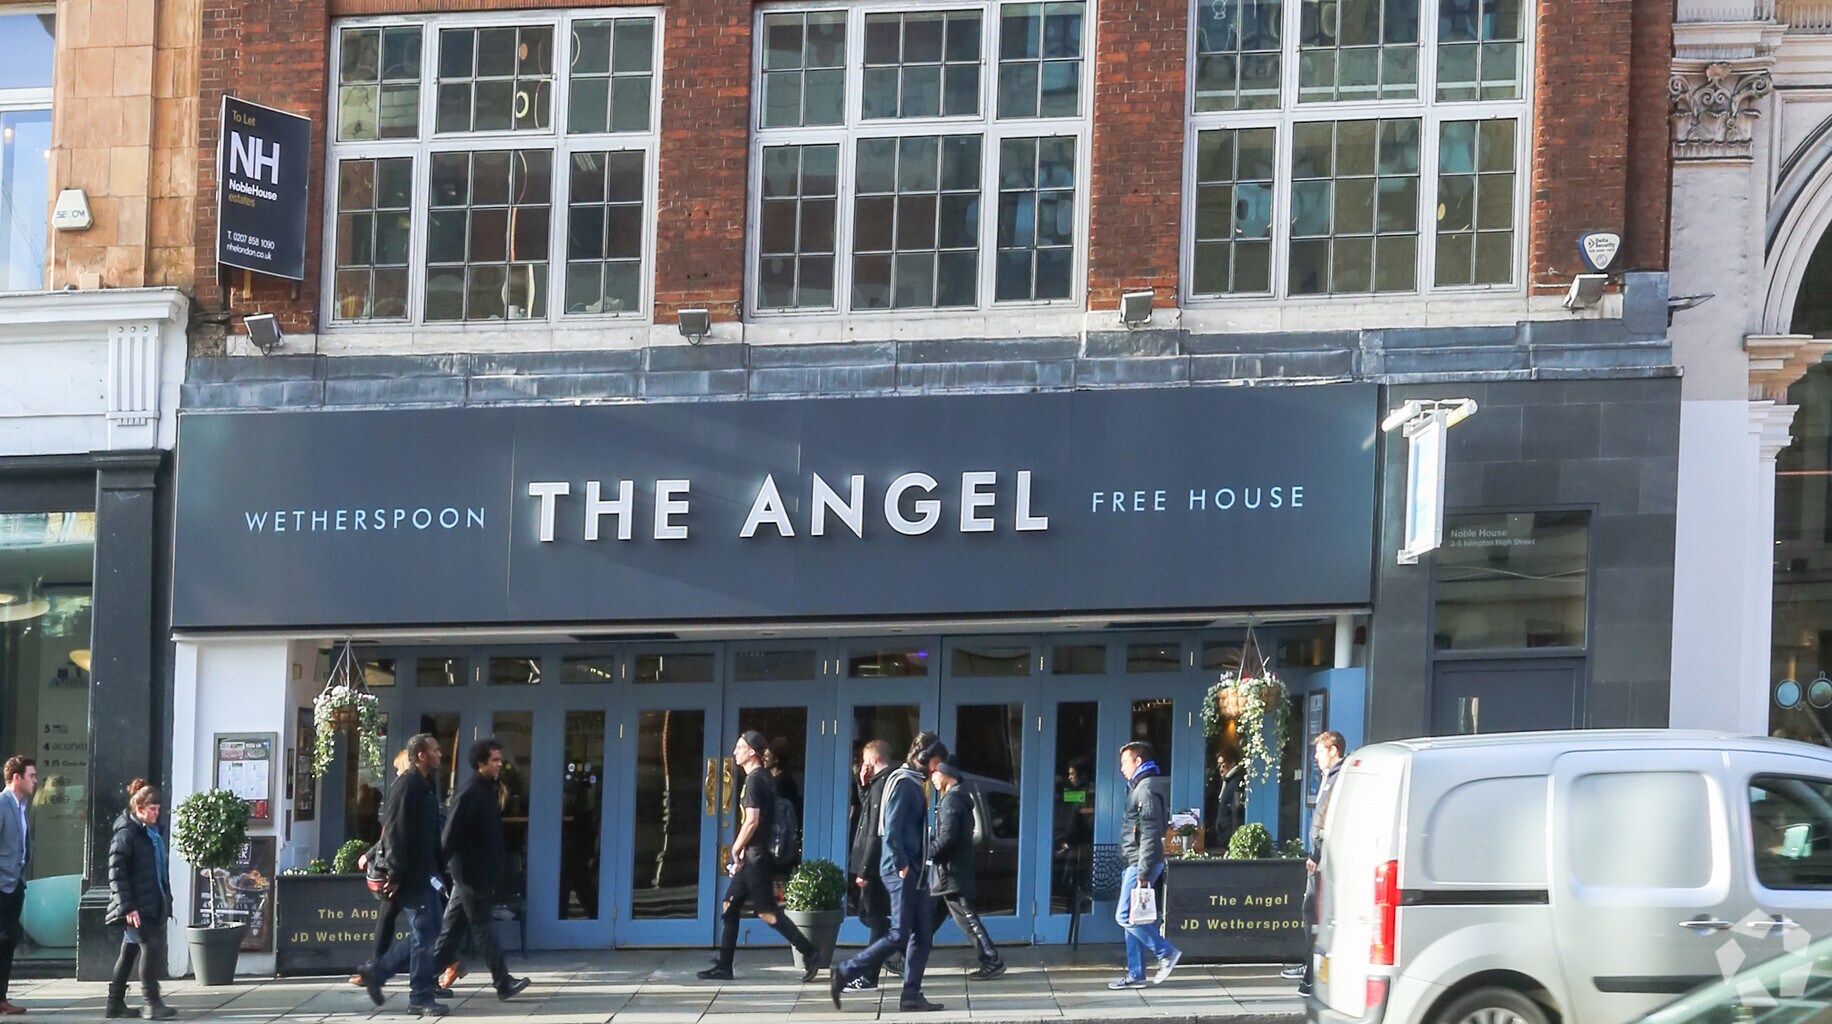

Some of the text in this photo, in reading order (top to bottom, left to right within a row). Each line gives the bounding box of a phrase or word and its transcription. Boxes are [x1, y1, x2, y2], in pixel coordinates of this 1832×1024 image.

[232, 110, 256, 127] To Let
[229, 130, 280, 185] NH
[229, 179, 278, 201] NobleHouse
[228, 193, 256, 208] estates
[233, 232, 248, 243] 0207
[261, 239, 275, 250] 1090
[244, 470, 1304, 542] WETHERSPOON THE ANGEL FREE HOUSE
[1450, 528, 1507, 538] Noble House
[1463, 539, 1494, 548] Islington
[1495, 538, 1512, 547] High
[1513, 538, 1536, 546] Street
[43, 742, 50, 751] 4
[1209, 894, 1288, 907] The Angel
[318, 908, 378, 920] The Ang
[1180, 919, 1200, 930] JD
[291, 931, 411, 942] JD Wetherso
